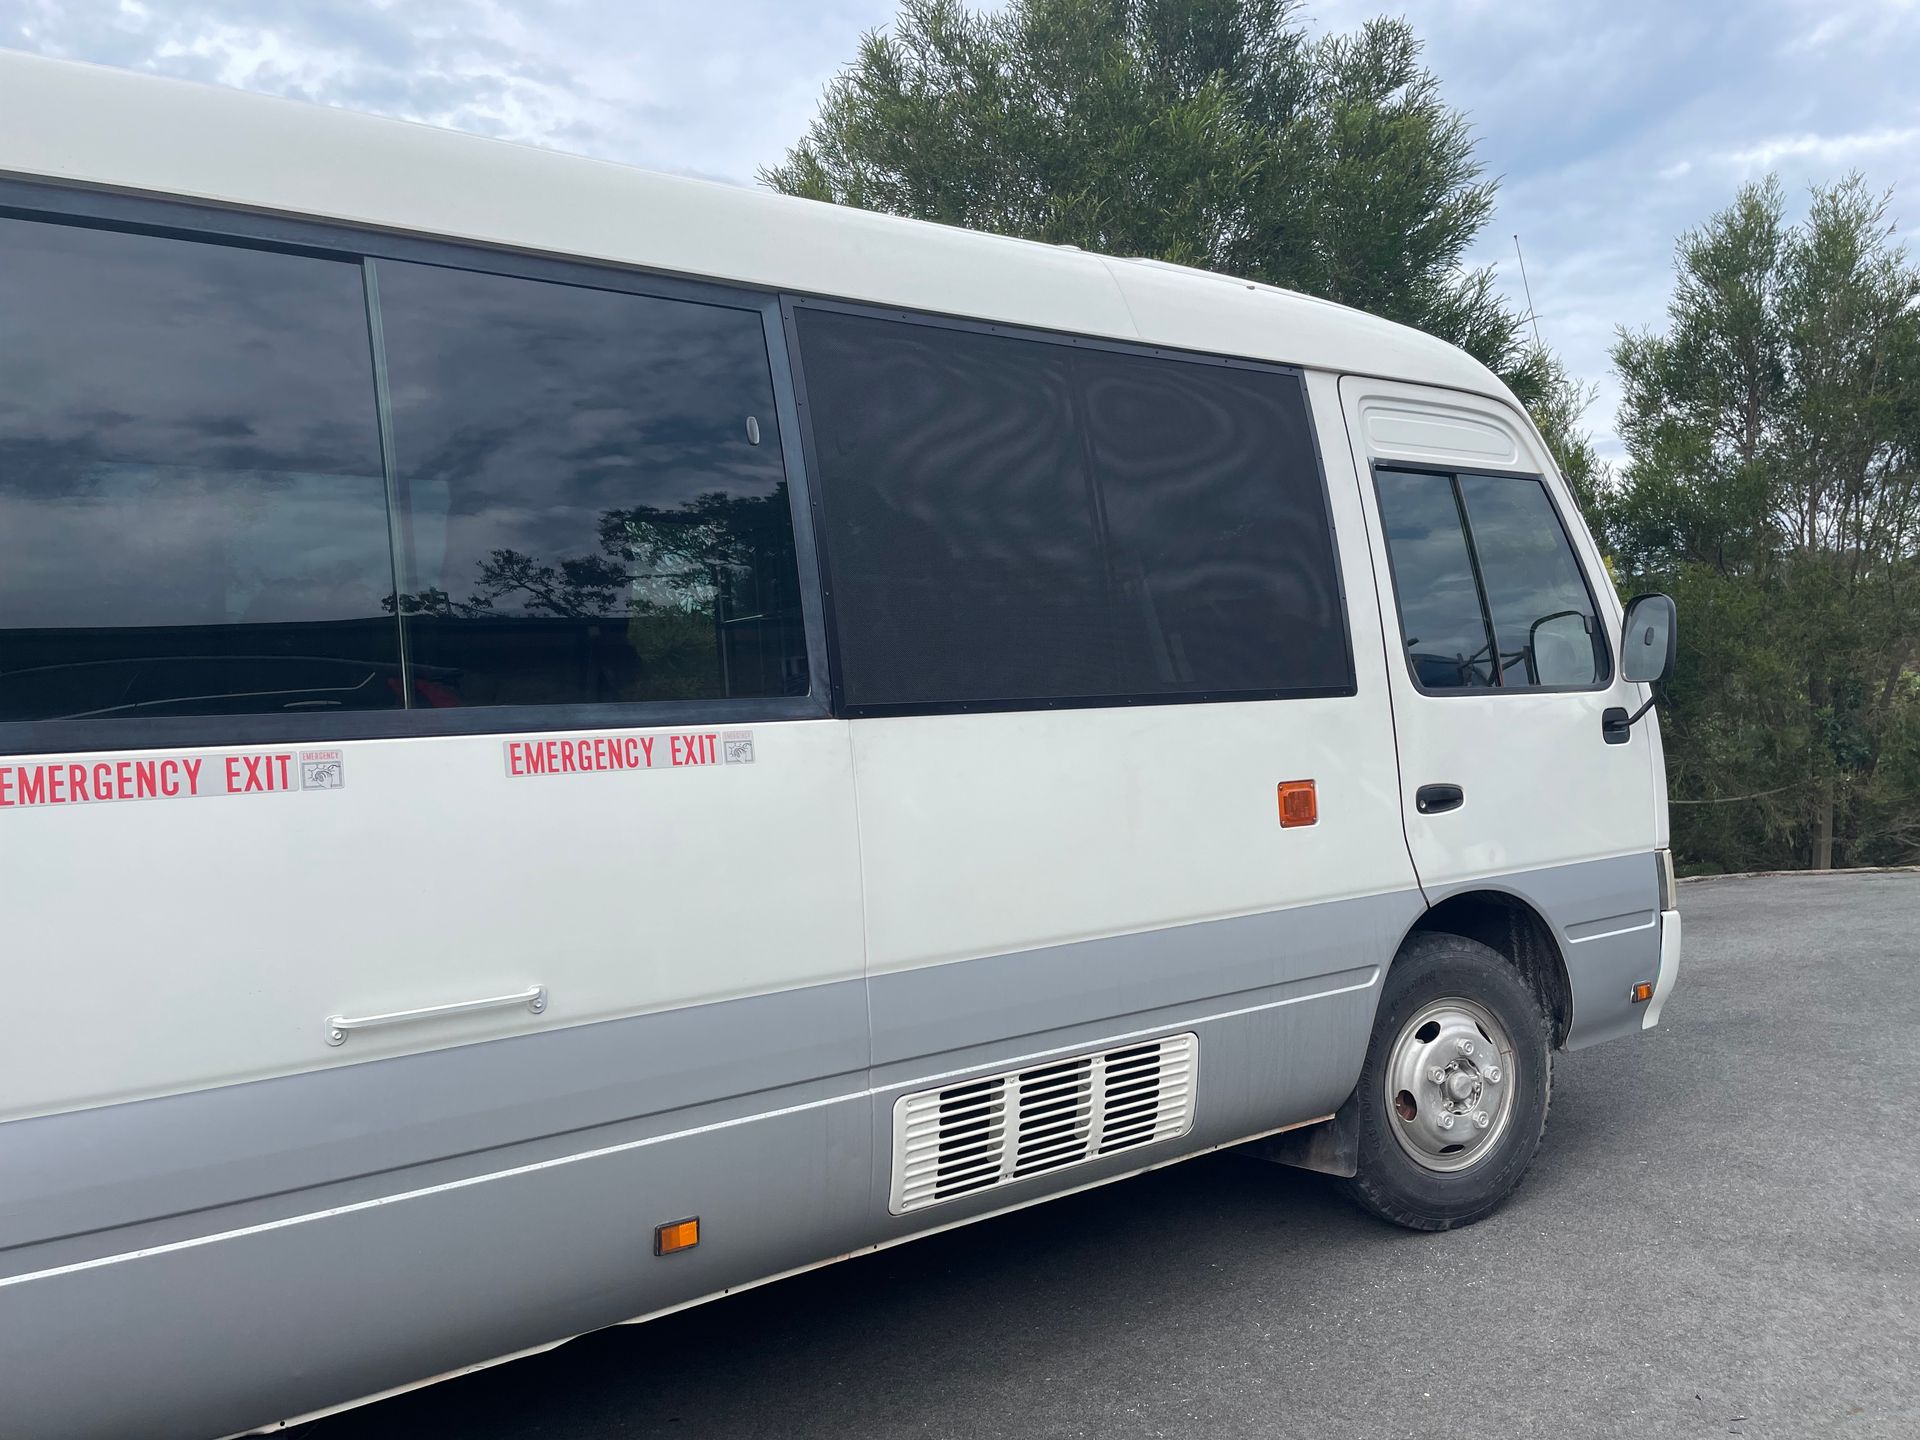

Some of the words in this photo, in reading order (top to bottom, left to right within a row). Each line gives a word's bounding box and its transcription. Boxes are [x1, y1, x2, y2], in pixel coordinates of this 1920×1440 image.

[302, 751, 339, 761] EMERGENCY
[509, 737, 654, 775] EMERGENCY
[670, 734, 717, 766] EXIT
[0, 758, 202, 805] EMERGENCY
[225, 755, 291, 793] EXIT
